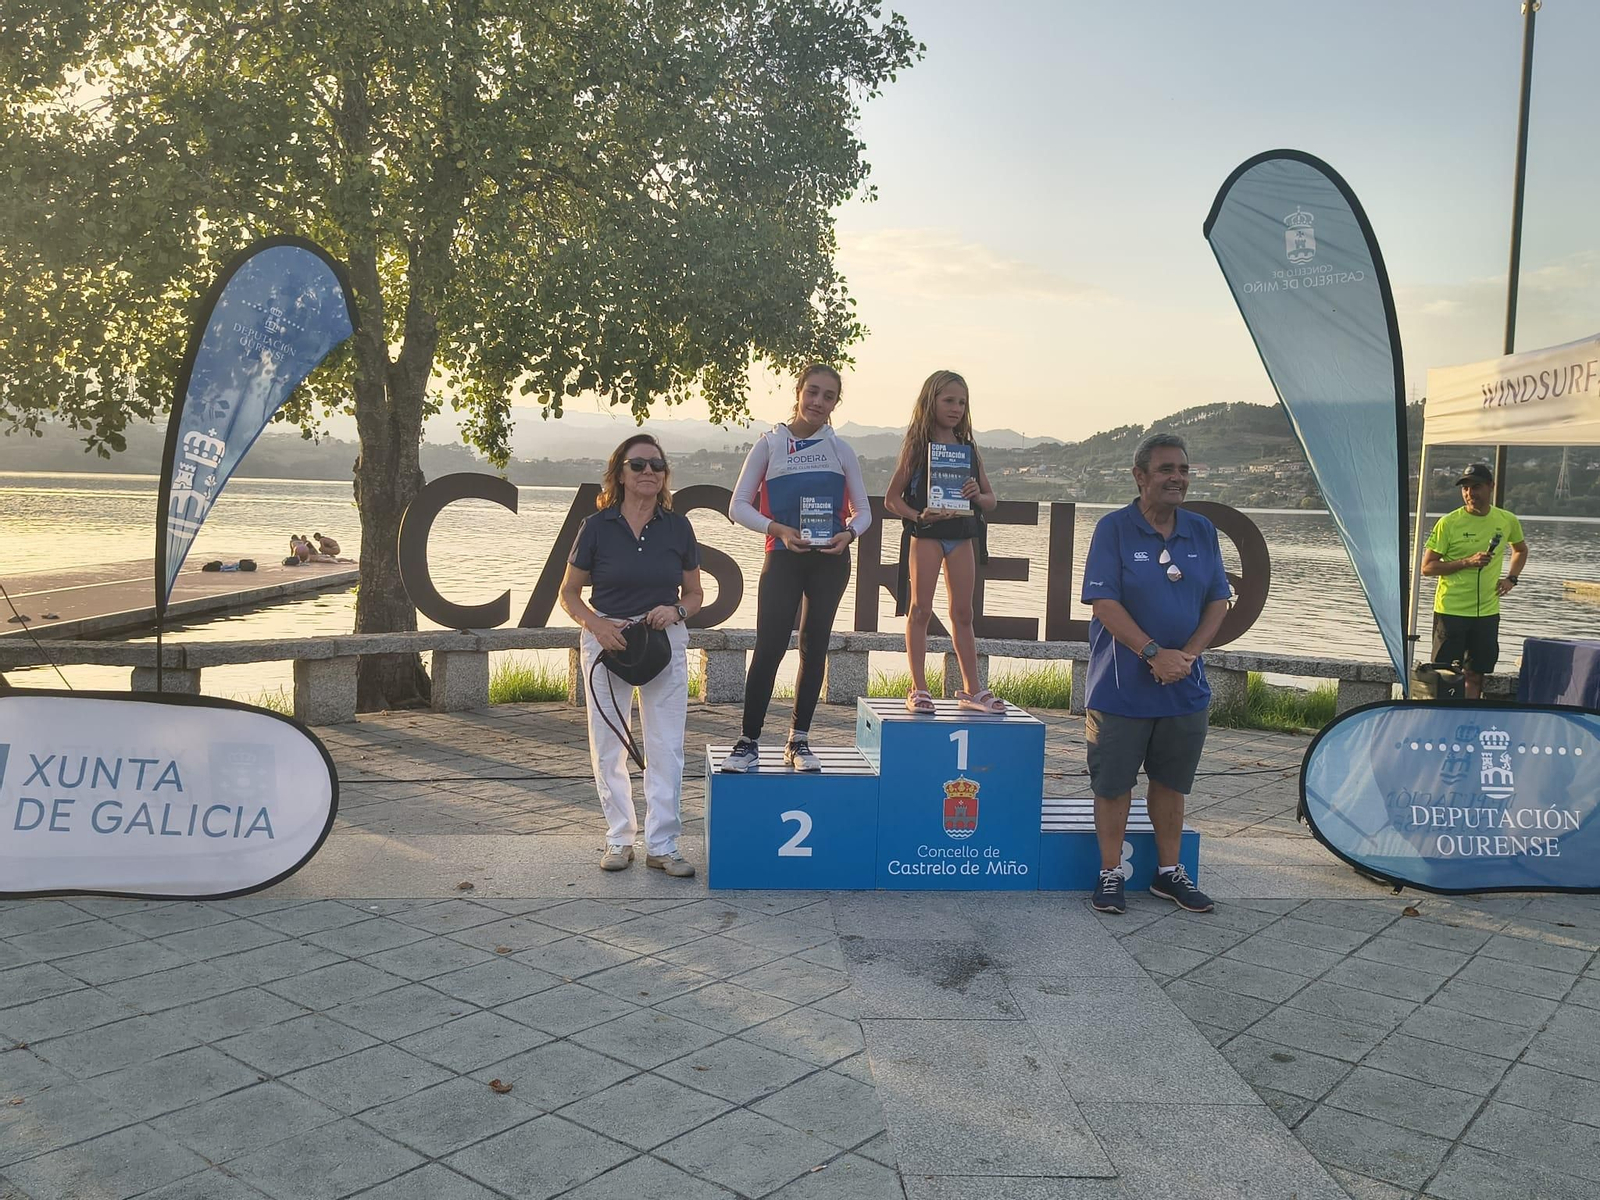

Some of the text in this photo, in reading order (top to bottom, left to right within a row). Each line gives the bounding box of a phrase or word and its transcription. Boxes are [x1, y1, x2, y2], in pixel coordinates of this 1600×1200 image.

[1481, 359, 1600, 409] WINDSURF
[787, 454, 828, 464] RODEIRA
[949, 729, 969, 770] 1
[22, 753, 184, 793] XUNTA
[13, 797, 275, 839] DE GALICIA
[777, 809, 813, 857] 2
[1410, 803, 1580, 831] DEPUTACIÓN
[917, 844, 1000, 858] Concello de
[1436, 834, 1561, 857] OURENSE
[887, 860, 1029, 875] Castrelo de Miño
